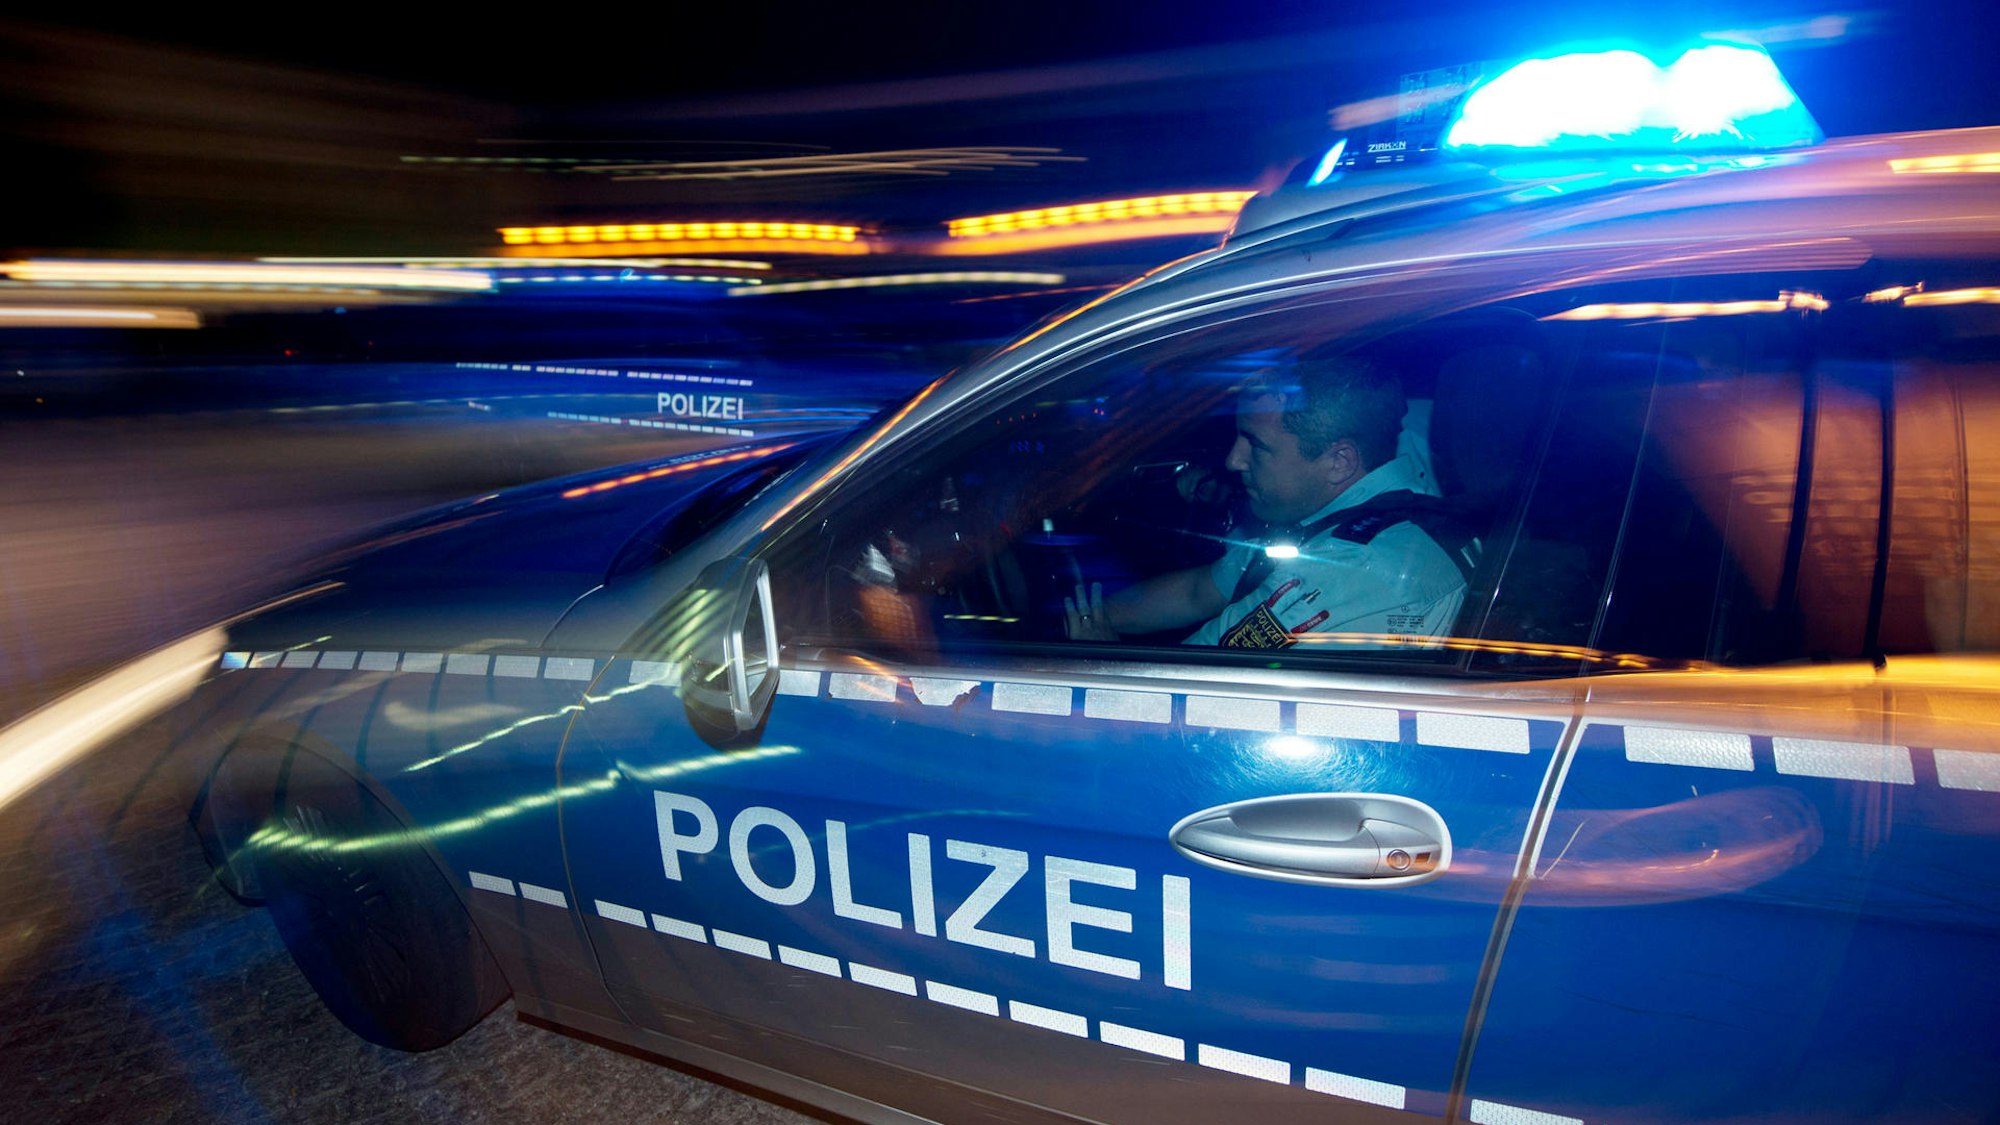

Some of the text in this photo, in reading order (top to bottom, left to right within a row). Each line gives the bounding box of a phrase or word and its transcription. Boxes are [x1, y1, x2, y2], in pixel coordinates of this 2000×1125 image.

[657, 392, 744, 420] POLIZEI
[1256, 610, 1283, 644] POLIZEI
[653, 790, 1192, 991] POLIZEI
